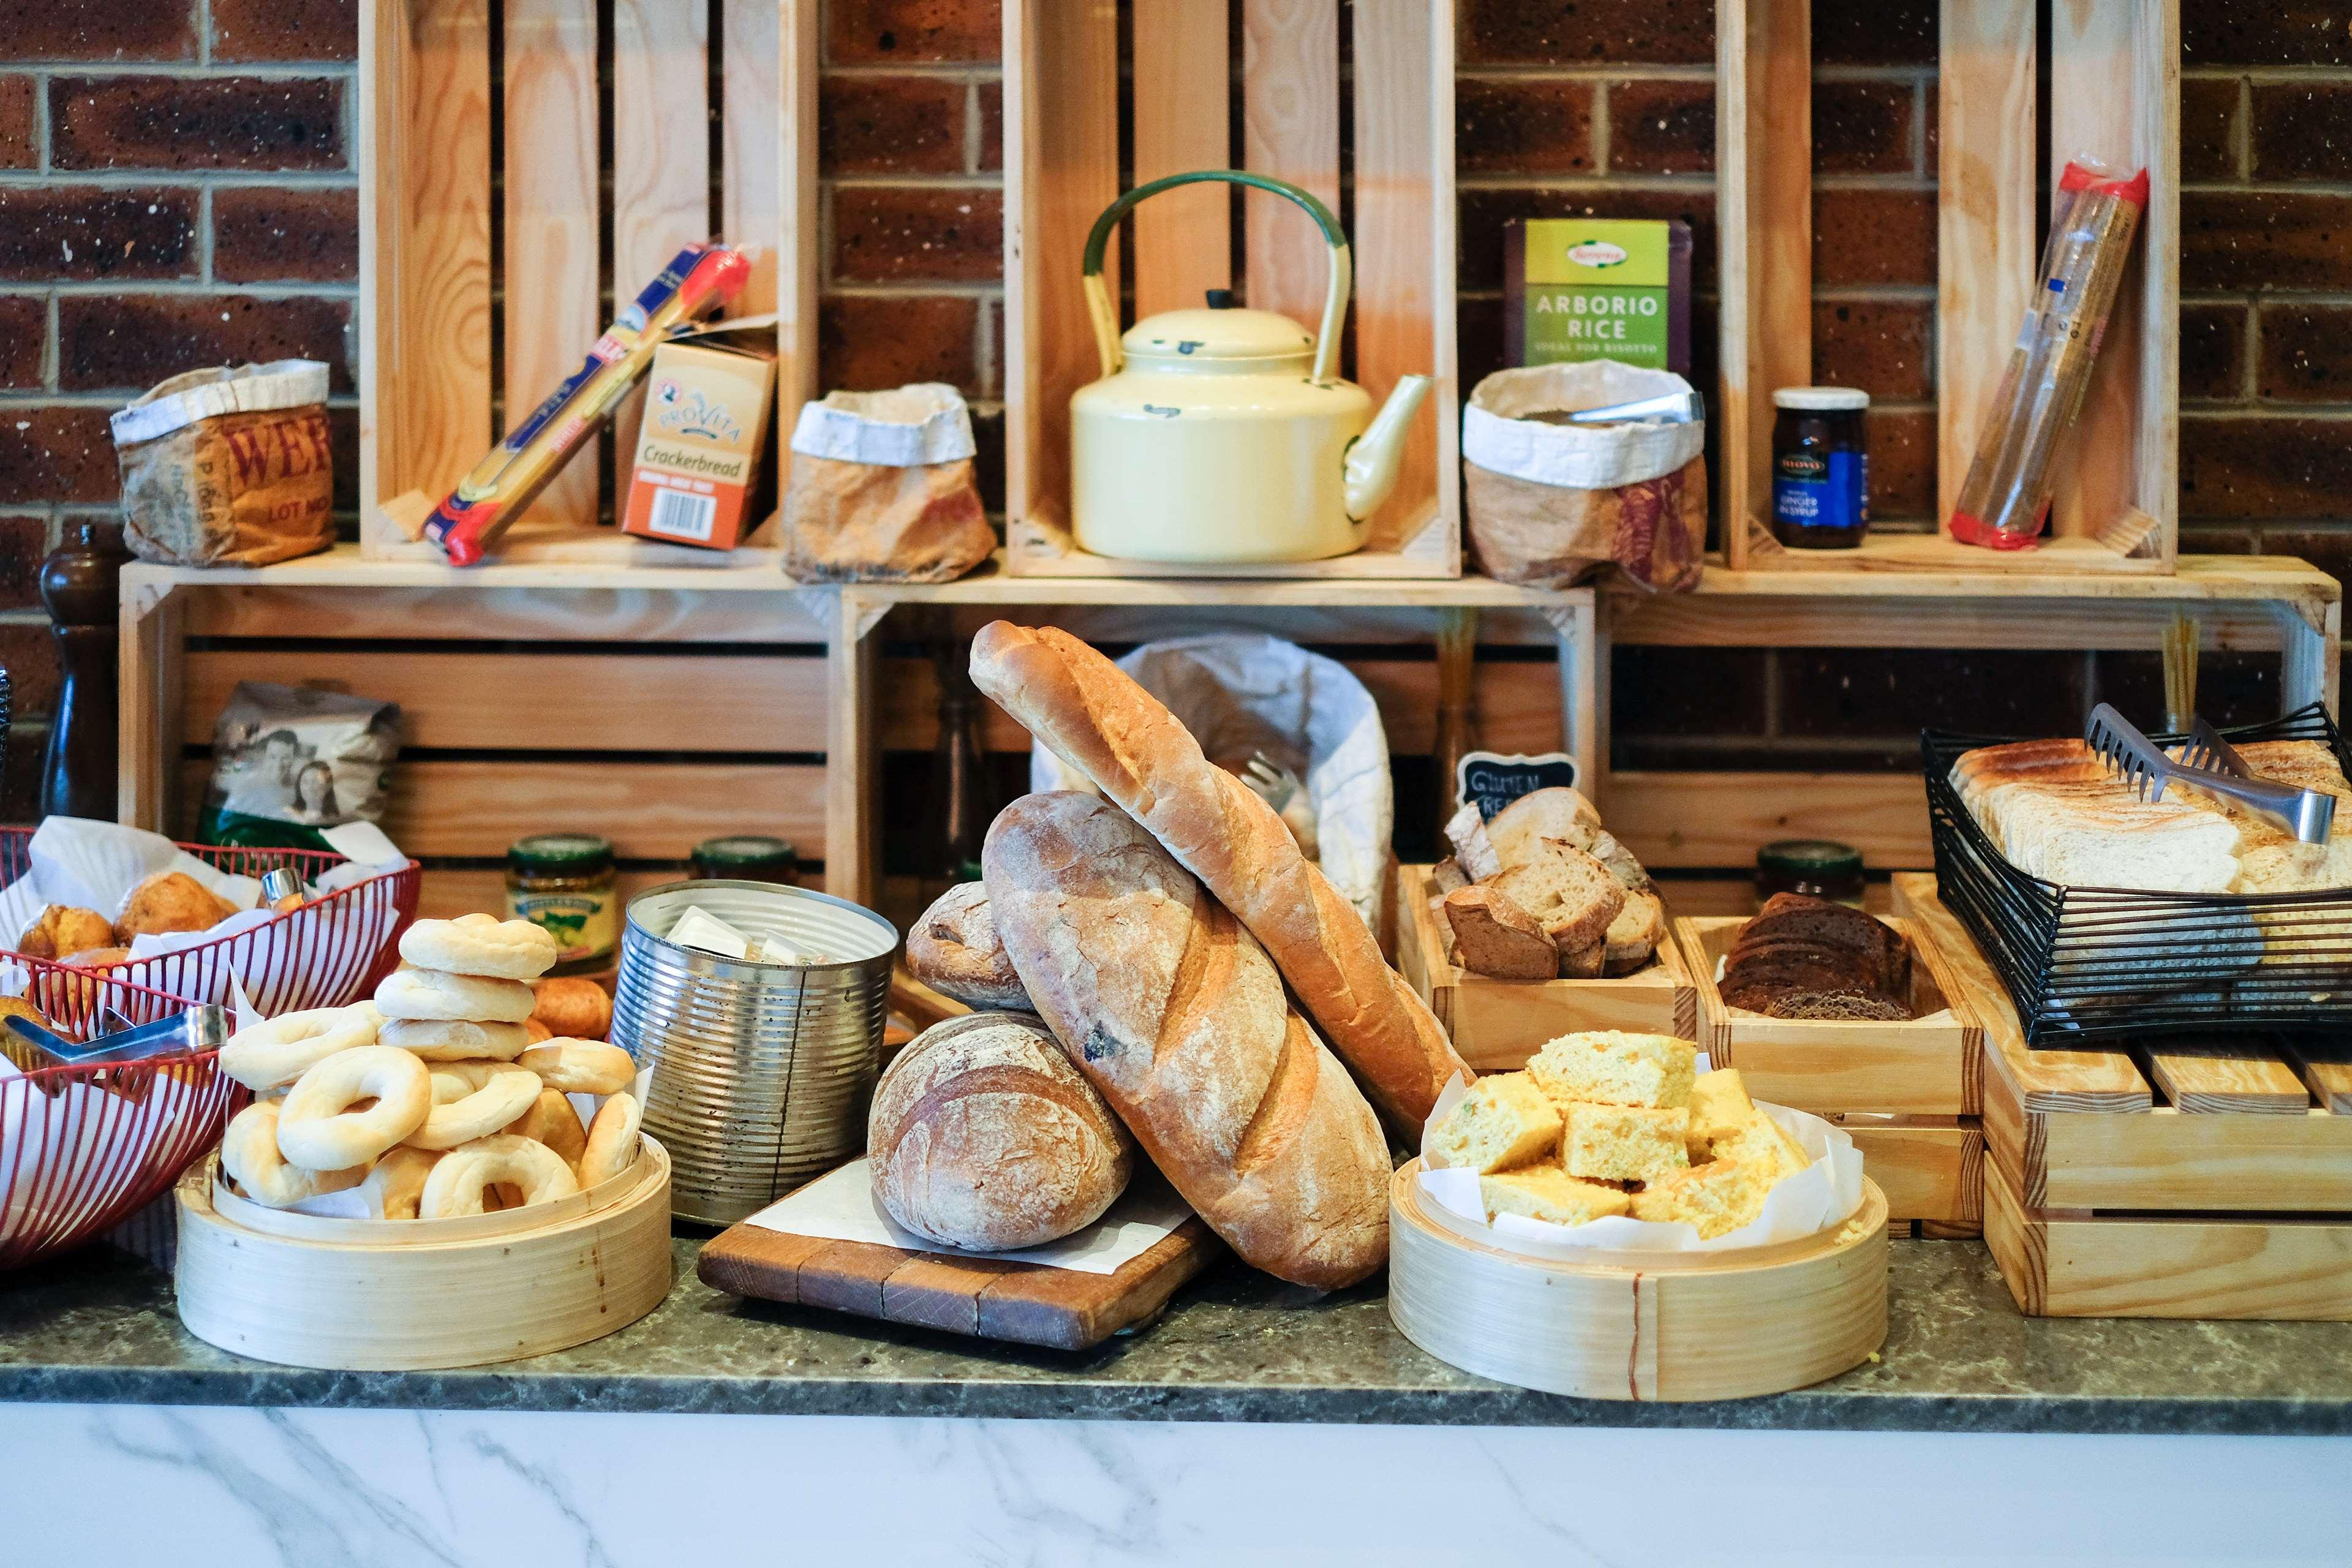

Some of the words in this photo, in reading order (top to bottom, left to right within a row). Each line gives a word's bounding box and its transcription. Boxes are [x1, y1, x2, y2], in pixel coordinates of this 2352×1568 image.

[1536, 295, 1658, 316] ARBORIO
[1567, 319, 1627, 339] RICE
[658, 389, 741, 442] PROVITA
[643, 443, 742, 478] Crackerbread
[268, 501, 301, 523] LOT
